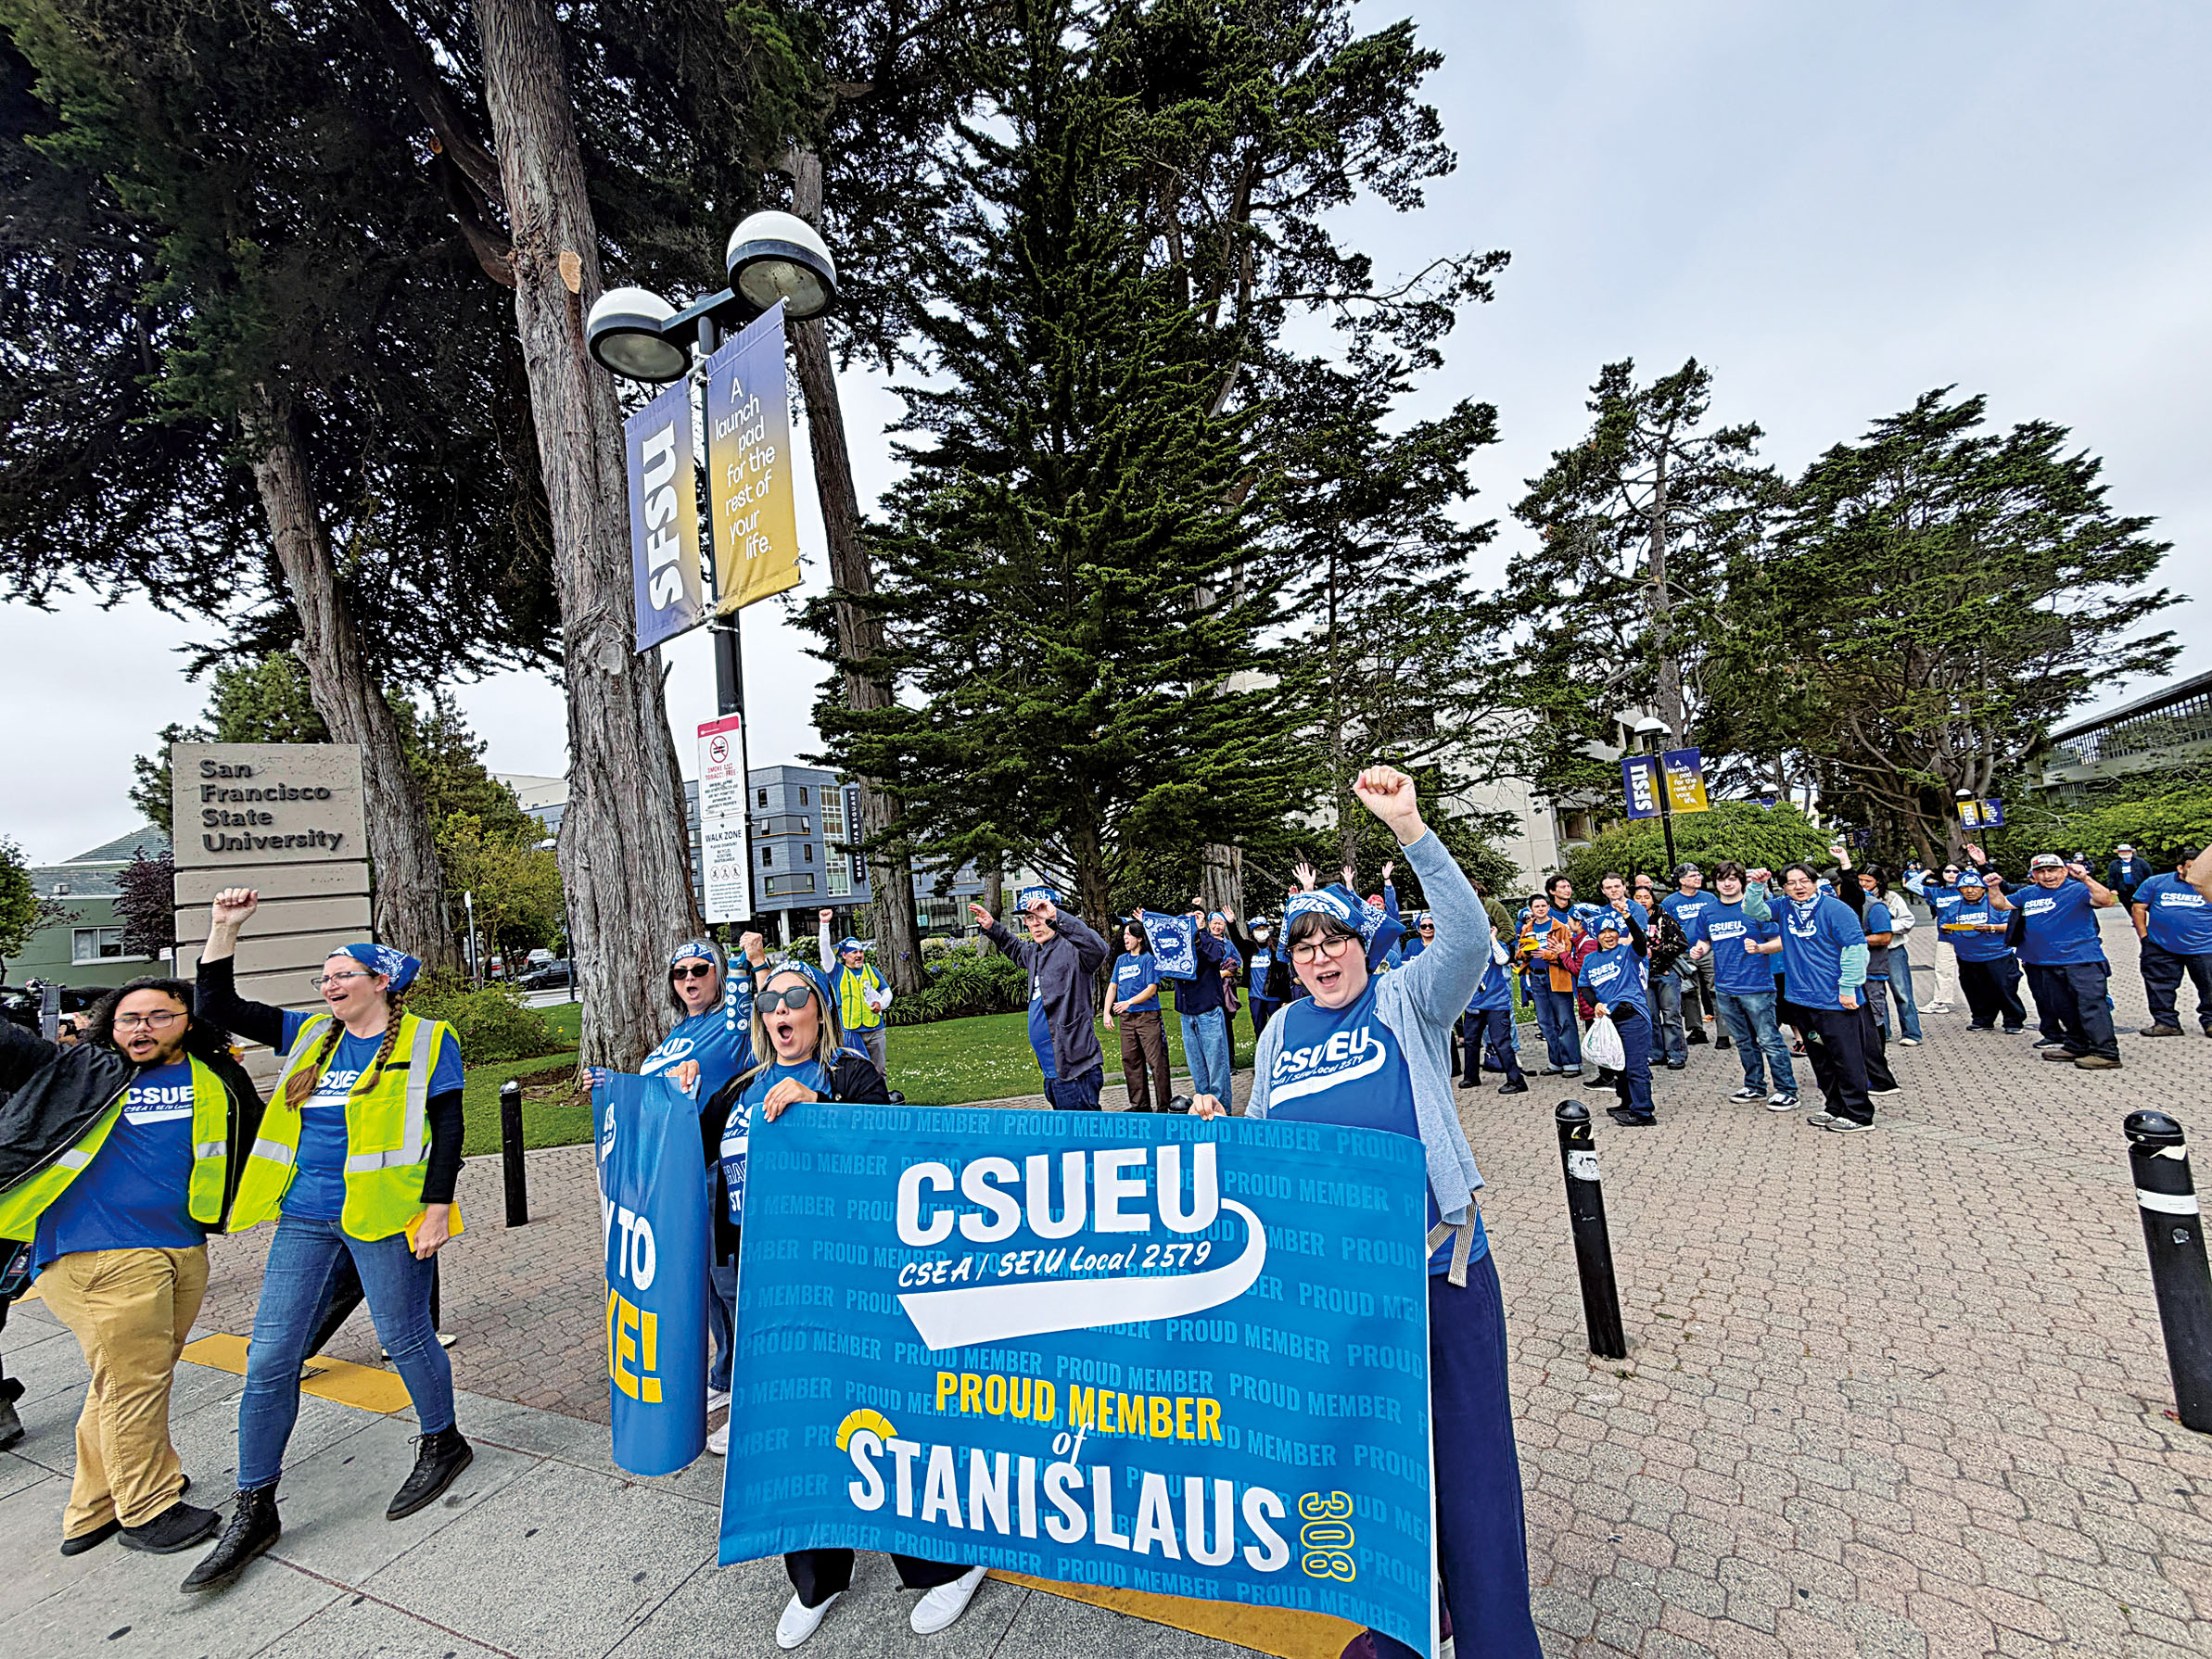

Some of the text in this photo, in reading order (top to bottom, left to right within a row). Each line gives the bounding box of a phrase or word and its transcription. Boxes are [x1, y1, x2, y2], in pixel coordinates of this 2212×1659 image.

[731, 378, 744, 404] A
[716, 394, 760, 441] launch
[738, 415, 765, 459] pad
[727, 447, 776, 488] for the
[643, 420, 684, 611] SFSU
[726, 468, 772, 517] rest of
[729, 509, 760, 546] your
[745, 536, 772, 560] life.
[199, 759, 251, 779] San
[200, 782, 330, 803] Francisco
[1630, 763, 1653, 812] SFSU
[1668, 765, 1690, 774] launch
[202, 807, 273, 827] State
[202, 829, 342, 852] University
[706, 830, 742, 842] WALK ZONE
[1709, 920, 1742, 933] CSUEU
[851, 1111, 911, 1133] PROUD
[917, 1113, 991, 1135] MEMBER
[1003, 1115, 1066, 1137] PROUD
[1074, 1118, 1151, 1141] MEMBER
[1165, 1119, 1232, 1144] PROUD
[1238, 1125, 1321, 1153] MEMBER
[1337, 1132, 1407, 1163] PROUD
[752, 1150, 812, 1174] PROUD
[817, 1153, 887, 1178] MEMBER
[1224, 1170, 1291, 1200] PROUD
[1299, 1179, 1390, 1212] MEMBER
[896, 1141, 1220, 1247] CSUEU
[617, 1206, 656, 1291] TO
[763, 1195, 835, 1218] MEMBER
[1341, 1236, 1417, 1271] PROUD
[812, 1239, 869, 1266] PROUD
[1299, 1282, 1375, 1318] PROUD
[898, 1241, 1212, 1288] CSEA / SEIU Local 2579
[757, 1284, 834, 1309] MEMBER
[1165, 1318, 1238, 1344] PROUD
[1245, 1323, 1331, 1365] MEMBER
[1347, 1344, 1424, 1380] PROUD
[741, 1331, 807, 1359] PROUD
[813, 1331, 882, 1361] MEMBER
[895, 1341, 958, 1369] PROUD
[963, 1347, 1043, 1375] MEMBER
[1057, 1355, 1121, 1388] PROUD
[1128, 1366, 1214, 1394] MEMBER
[1229, 1372, 1301, 1412] PROUD
[1307, 1390, 1403, 1425] MEMBER
[936, 1371, 1056, 1422] PROUD
[1069, 1384, 1223, 1441] MEMBER
[752, 1377, 833, 1405] MEMBER
[845, 1380, 901, 1412] PROUD
[1248, 1429, 1337, 1467] MEMBER
[1354, 1443, 1428, 1491] PROUD
[1052, 1422, 1094, 1464] of
[745, 1474, 828, 1506] MEMBER
[846, 1429, 1290, 1573] STANISLAUS
[1299, 1490, 1356, 1583] 308
[895, 1529, 958, 1562] PROUD
[963, 1542, 1043, 1577] MEMBER
[1057, 1556, 1126, 1586] PROUD
[1134, 1566, 1220, 1600] MEMBER
[1237, 1580, 1312, 1610] PROUD
[1319, 1588, 1412, 1640] MEMBER
